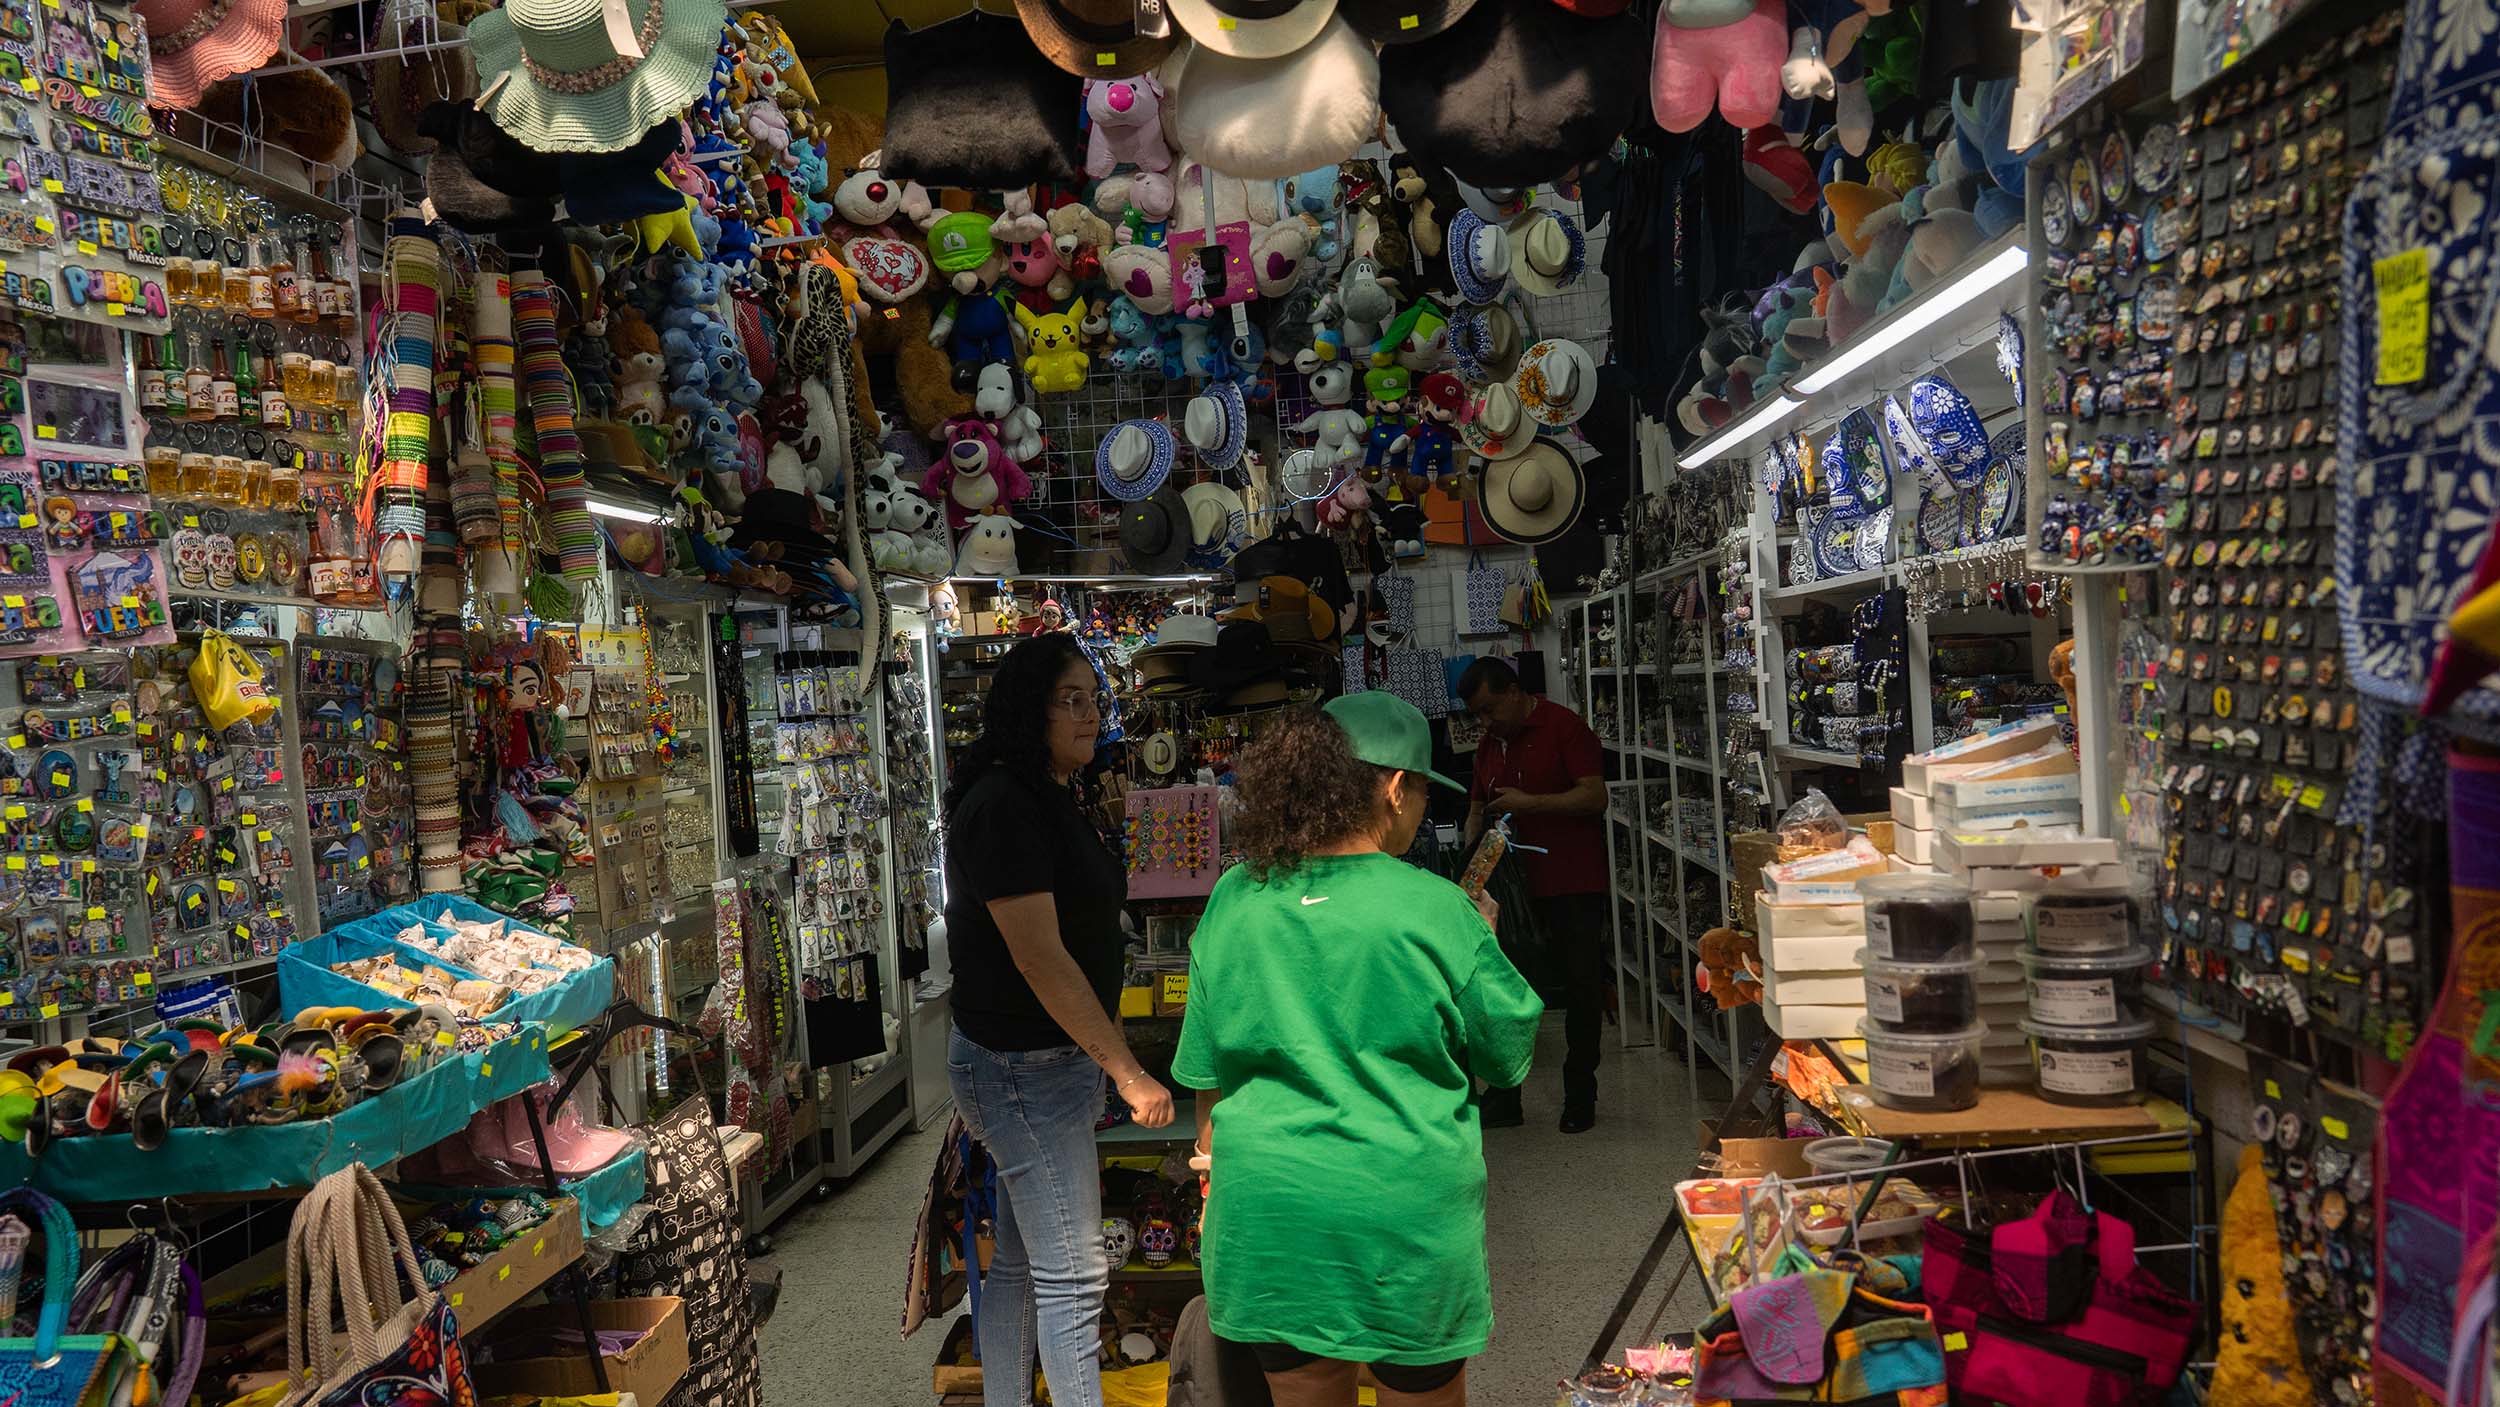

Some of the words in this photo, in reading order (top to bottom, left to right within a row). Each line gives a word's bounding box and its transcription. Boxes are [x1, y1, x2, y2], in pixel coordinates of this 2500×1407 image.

[44, 78, 153, 138] Puebla
[128, 250, 166, 266] México
[63, 265, 167, 318] PUEBLA
